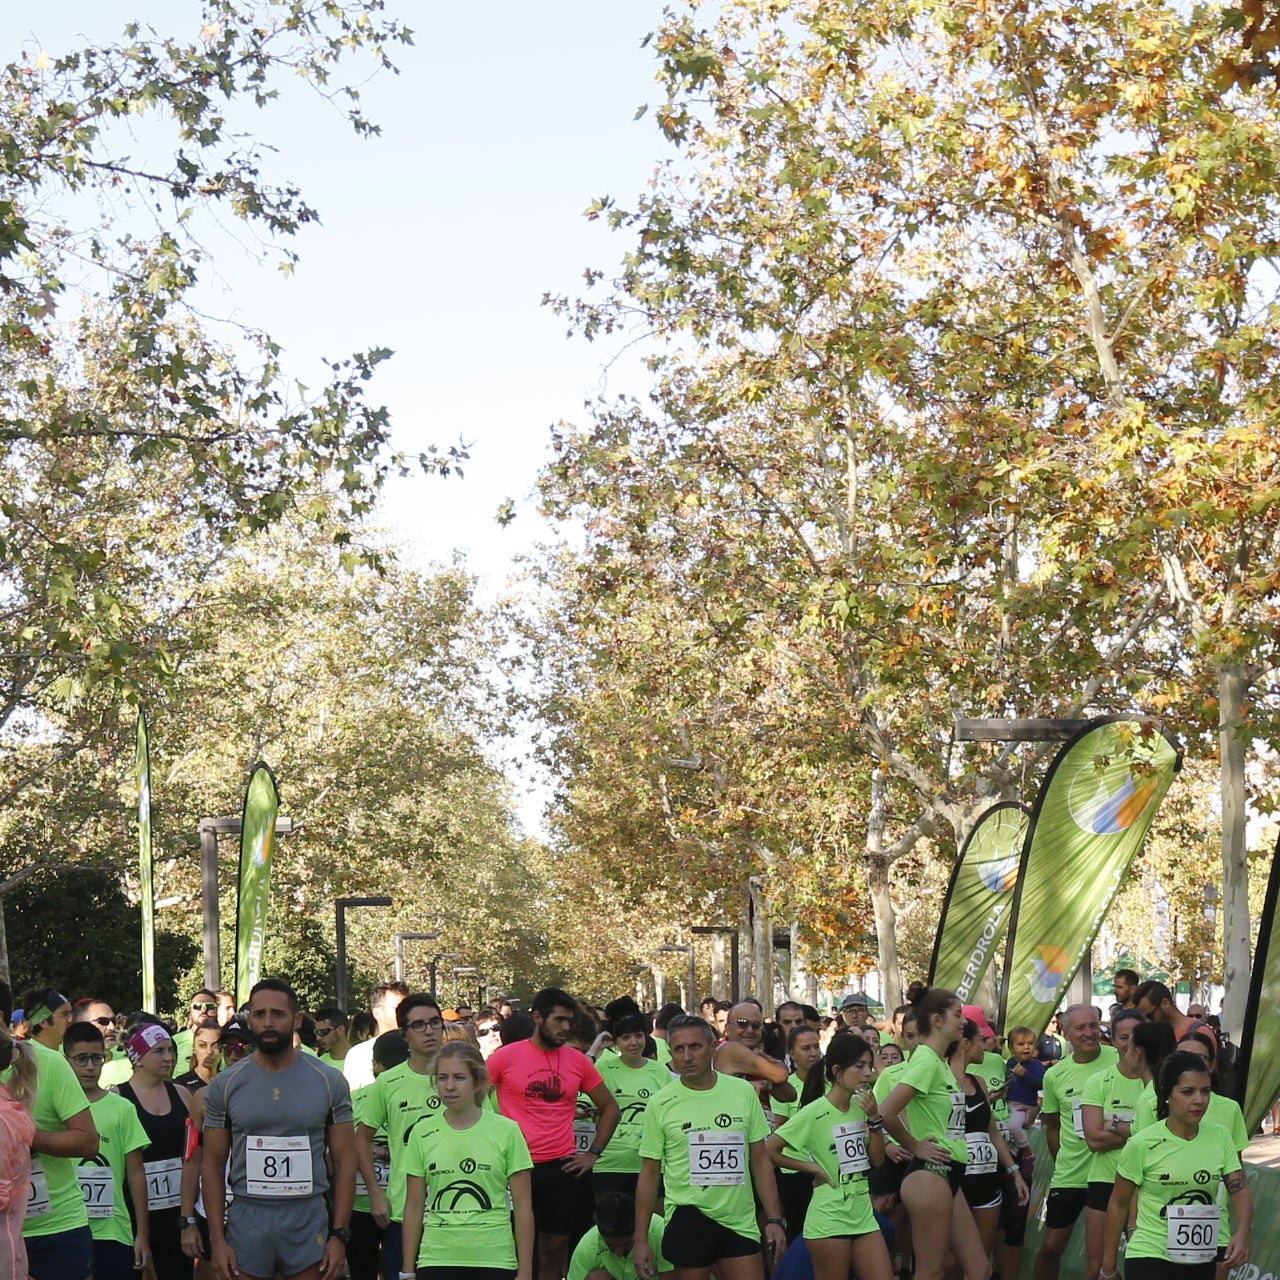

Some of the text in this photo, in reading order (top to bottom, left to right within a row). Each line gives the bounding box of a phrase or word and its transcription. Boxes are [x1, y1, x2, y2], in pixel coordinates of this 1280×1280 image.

[954, 903, 1007, 1007] BERDROLA
[263, 1155, 291, 1178] 81
[698, 1149, 739, 1170] 545
[150, 1174, 171, 1197] 11
[1176, 1224, 1213, 1246] 560
